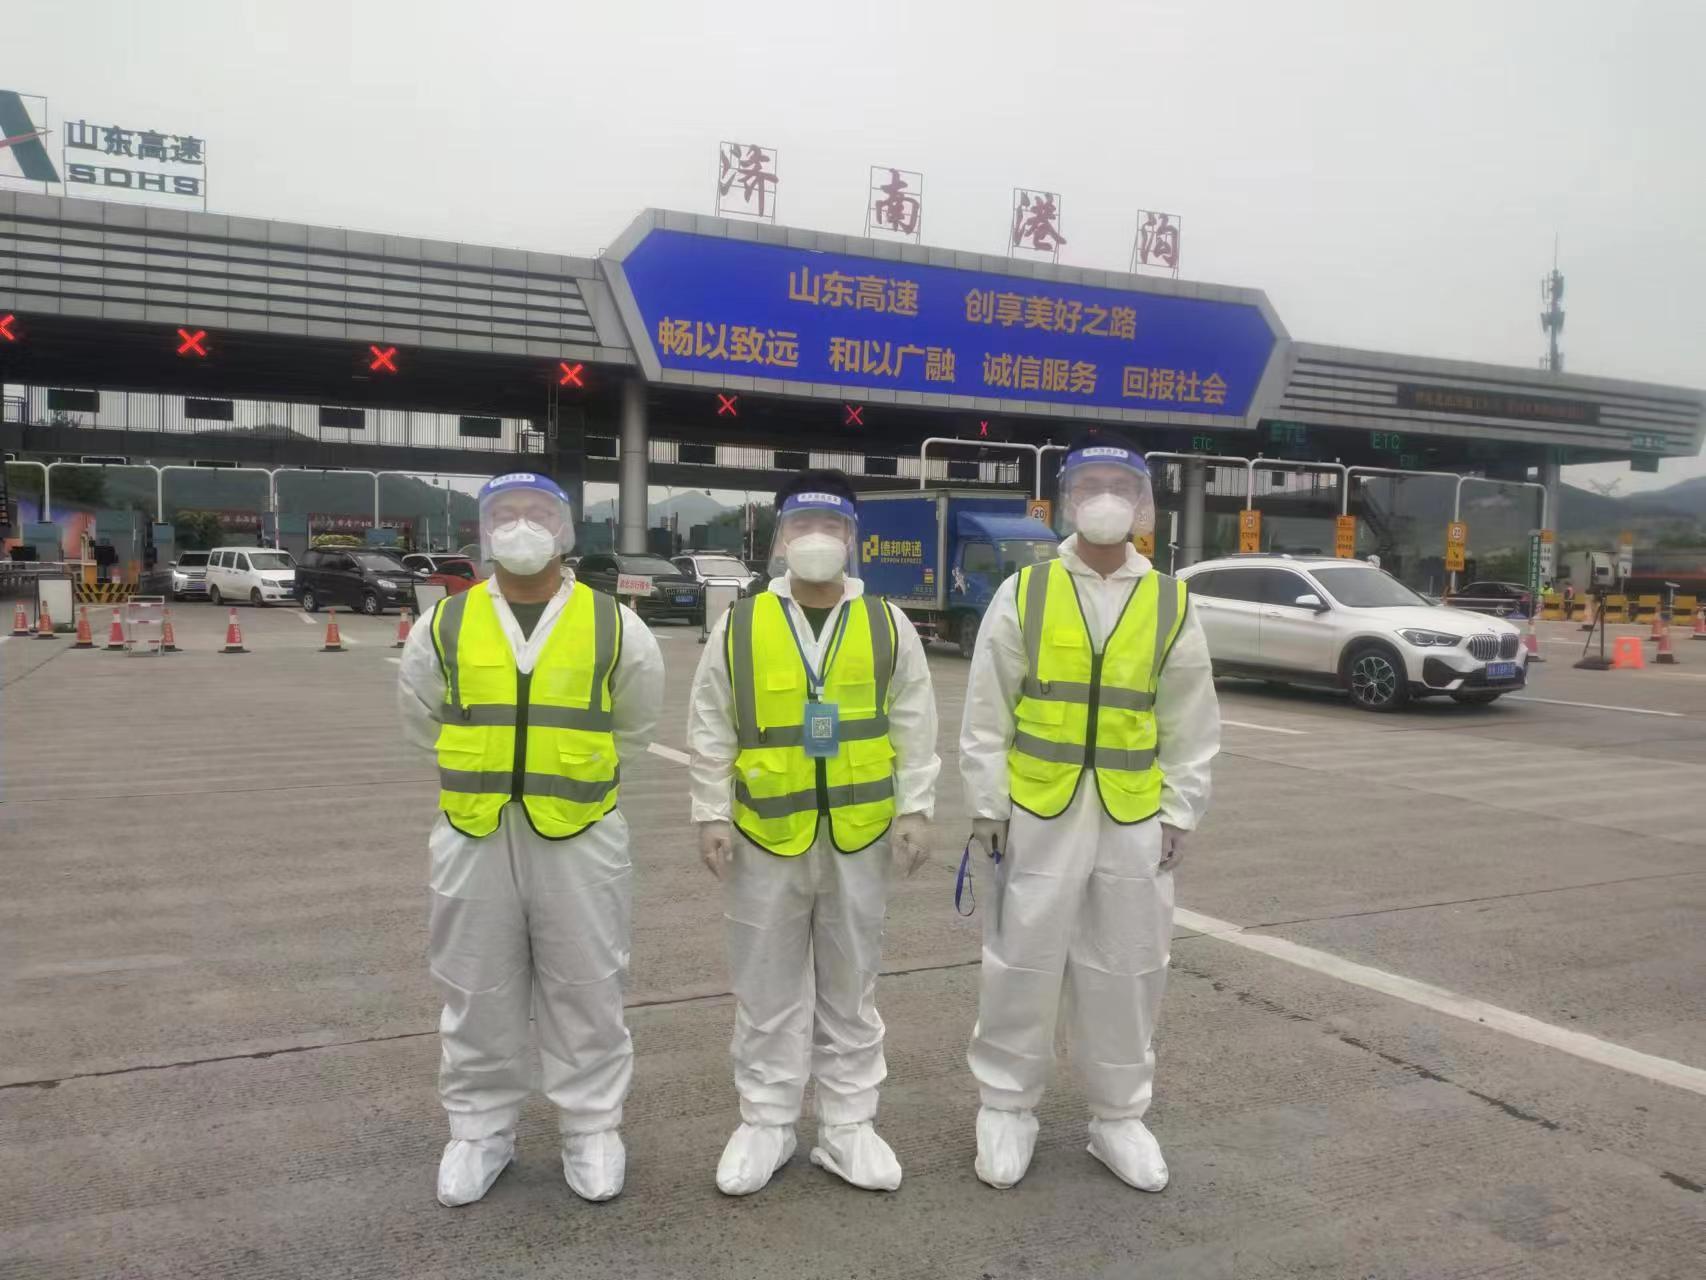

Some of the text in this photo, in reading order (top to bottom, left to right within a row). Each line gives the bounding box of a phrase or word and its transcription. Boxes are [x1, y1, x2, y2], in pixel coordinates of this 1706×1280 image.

[67, 119, 203, 165] 山东高速
[69, 164, 199, 195] SDHS
[788, 266, 1138, 341] 山东高速 创享美好之路
[657, 318, 1228, 406] 畅以致远 和以广融 诚信服务 回报社会
[1192, 437, 1213, 450] ETC
[880, 540, 922, 557] 德邦快递
